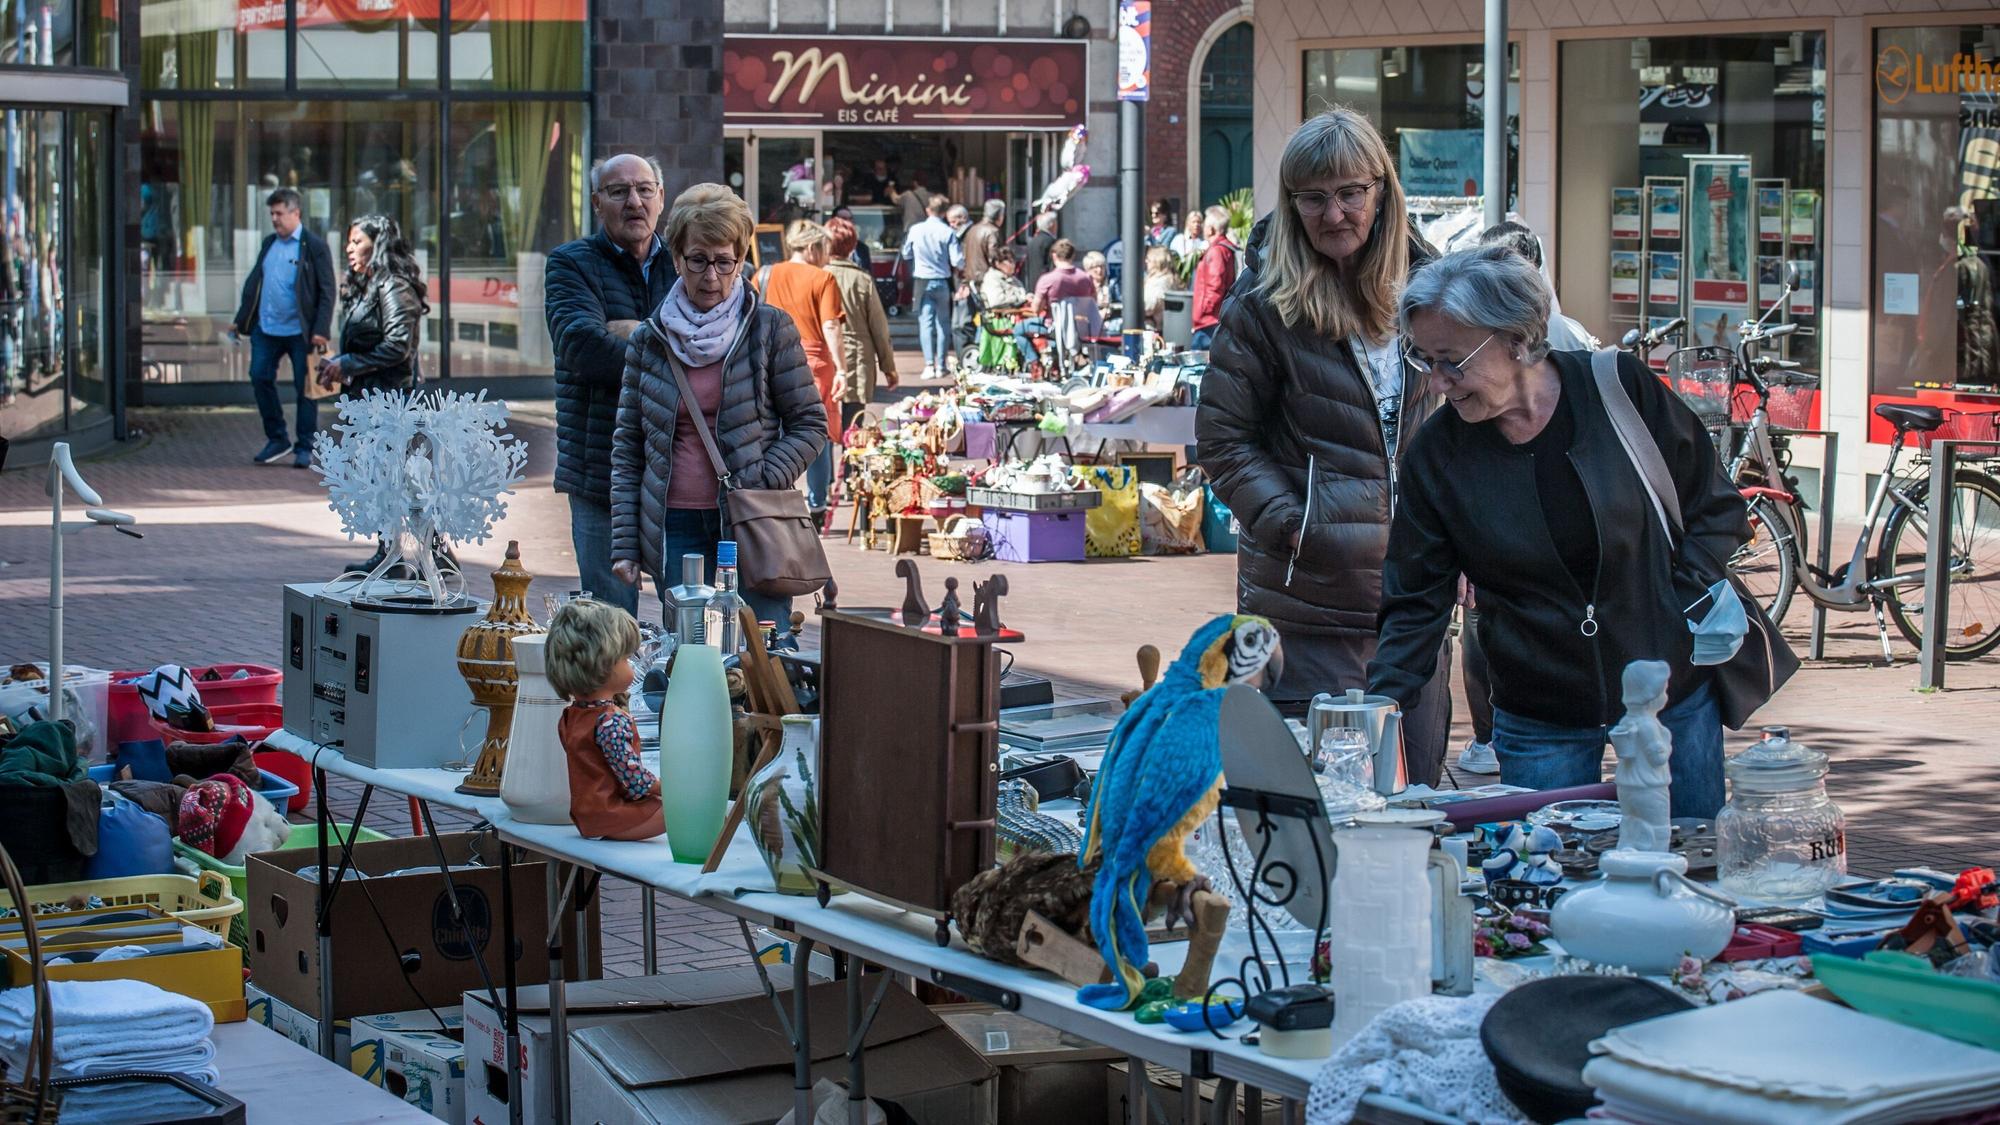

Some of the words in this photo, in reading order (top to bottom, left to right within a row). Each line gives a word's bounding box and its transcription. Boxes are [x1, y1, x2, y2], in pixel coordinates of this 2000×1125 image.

[768, 47, 973, 105] Minini
[838, 109, 859, 122] EIS
[864, 106, 899, 122] CAFÉ
